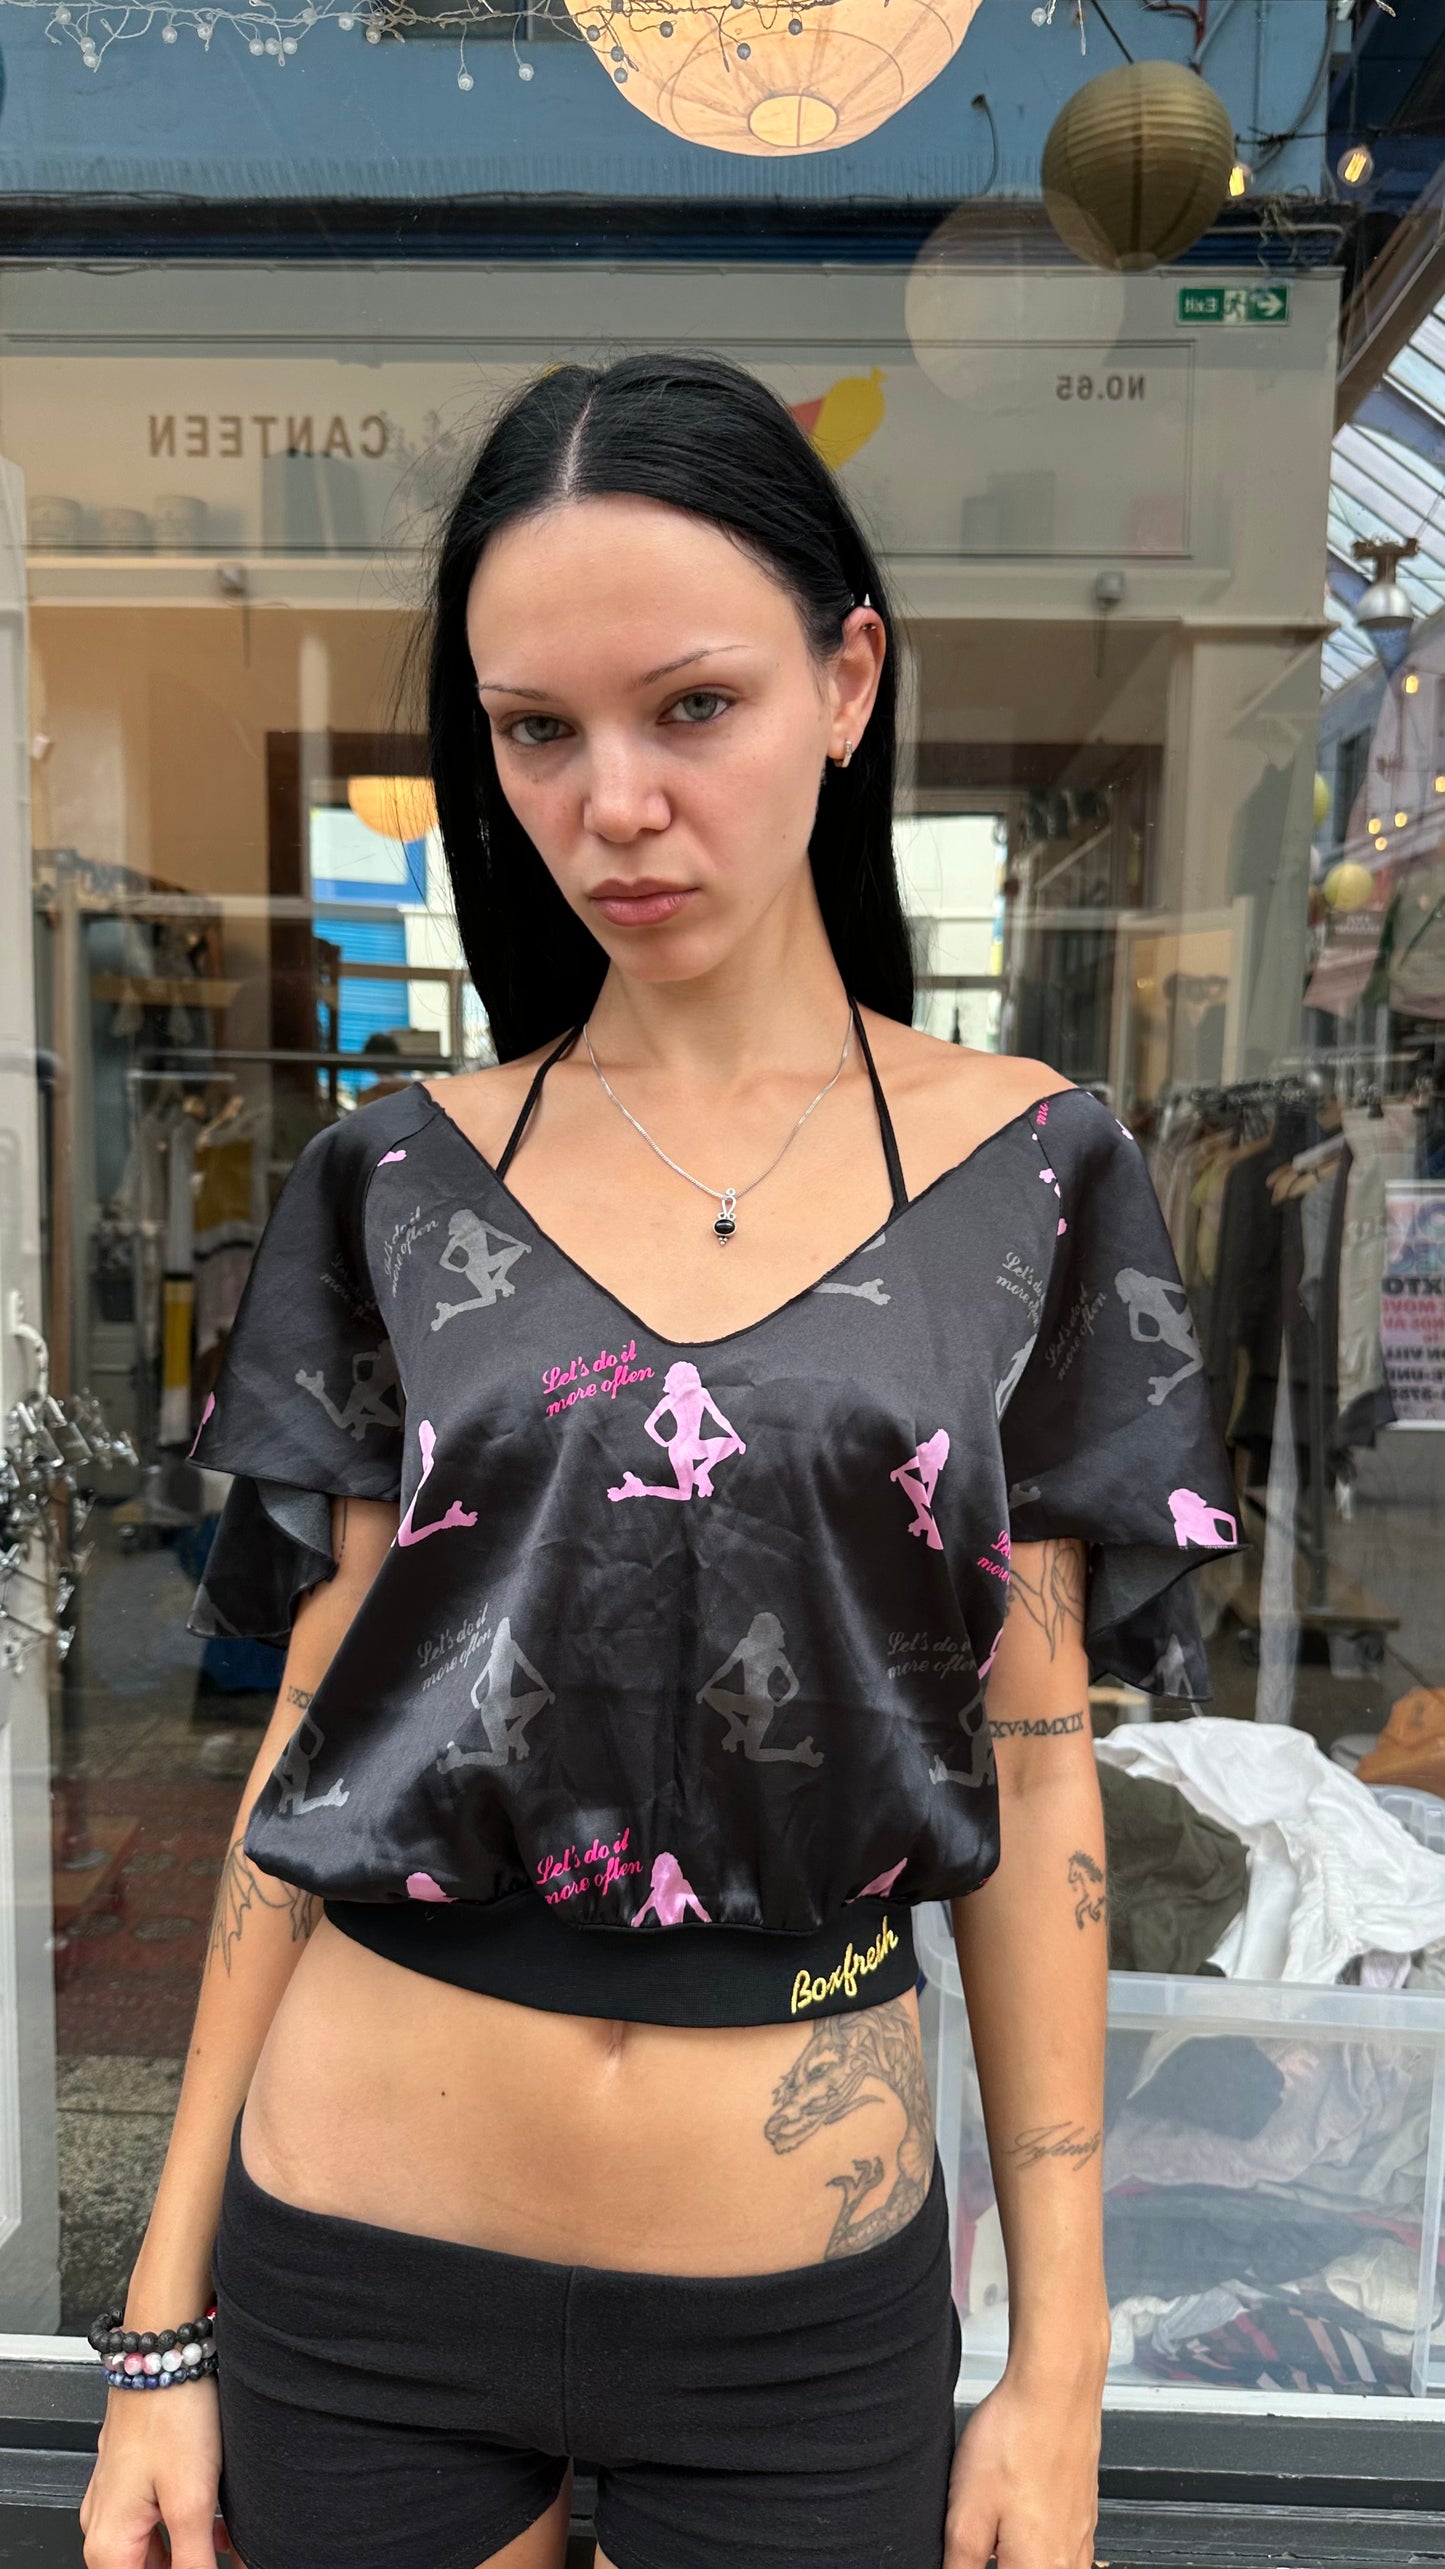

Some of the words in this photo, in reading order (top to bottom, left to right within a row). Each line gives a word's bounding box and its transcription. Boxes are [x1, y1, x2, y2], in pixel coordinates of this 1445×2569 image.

[996, 1274, 1030, 1304] more
[1002, 1251, 1034, 1285] Let's
[542, 1356, 591, 1395] Let's
[593, 1350, 619, 1373] do
[620, 1339, 637, 1363] it
[546, 1383, 598, 1418] more
[600, 1365, 655, 1400] often
[417, 1628, 454, 1669] Let's
[456, 1618, 475, 1643] do
[476, 1602, 489, 1630] it
[422, 1656, 458, 1693] more
[459, 1627, 492, 1669] often
[887, 1631, 929, 1656] Let's
[933, 1636, 958, 1652] do
[886, 1659, 930, 1680] more
[536, 1845, 582, 1885] Let's
[584, 1838, 611, 1864] do
[613, 1827, 631, 1854] it
[593, 1857, 644, 1896] often
[791, 1915, 900, 2015] Boxfresh
